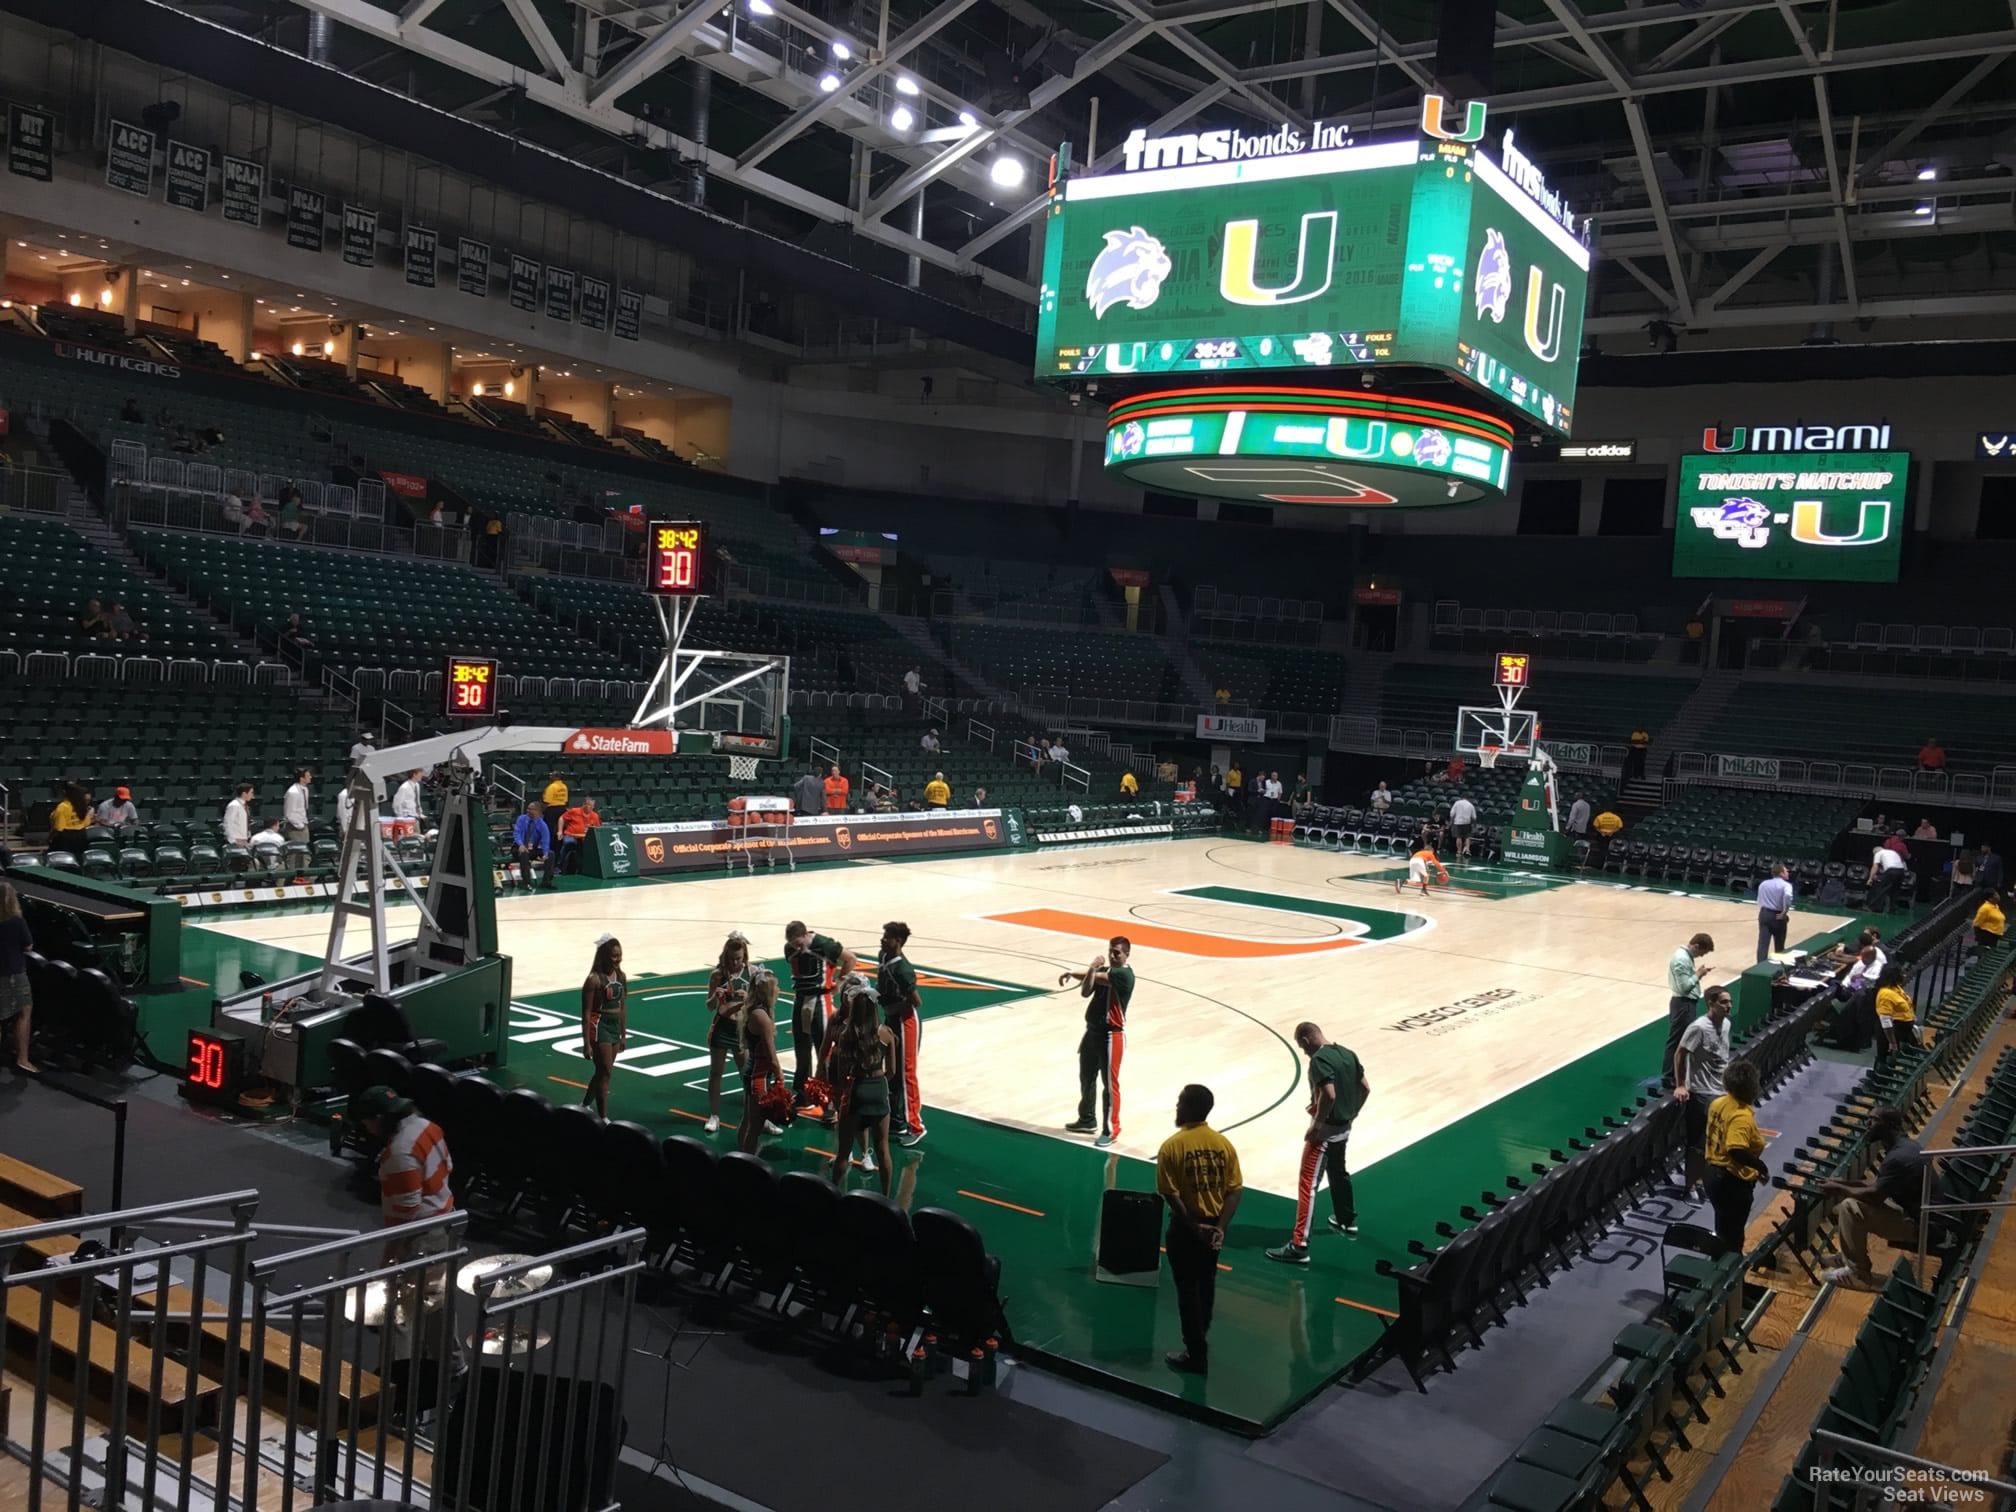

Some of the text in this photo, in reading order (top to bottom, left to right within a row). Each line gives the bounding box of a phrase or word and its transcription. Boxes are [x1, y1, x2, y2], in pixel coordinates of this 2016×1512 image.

[20, 113, 45, 137] NIT
[1422, 94, 1487, 142] U
[117, 128, 148, 152] ACC
[1310, 121, 1353, 150] Inc.
[174, 148, 203, 171] ACC
[1438, 143, 1467, 157] MIAMI
[225, 162, 260, 187] NCAA
[293, 190, 321, 214] NCAA
[346, 211, 375, 233] NIT
[408, 231, 434, 252] NIT
[461, 242, 487, 264] NCAA
[1219, 210, 1338, 307] U
[514, 260, 538, 281] NIT
[548, 270, 572, 289] NIT
[584, 280, 606, 300] NIT
[1524, 265, 1566, 363] U
[1260, 338, 1272, 356] 0
[1349, 333, 1392, 345] 2 FOULS
[1058, 348, 1081, 358] FOULS
[1105, 342, 1173, 373] U 0
[1194, 341, 1237, 359] 38:42
[1358, 348, 1391, 359] 4 TOL
[77, 348, 181, 379] Hurricanes
[1058, 362, 1072, 370] TOL
[1326, 417, 1387, 459] U
[1703, 427, 1747, 453] U
[1587, 445, 1632, 457] adidas
[1698, 472, 1893, 491] TONIGHT'S MATCHUP
[1791, 501, 1892, 546] U
[658, 529, 698, 549] 38:42
[661, 551, 692, 585] 30
[1501, 656, 1526, 667] 38:42
[453, 665, 489, 682] 38:42
[1502, 666, 1522, 683] 30
[458, 685, 481, 706] 30
[673, 844, 698, 854] Official
[700, 842, 733, 854] Corporate
[759, 839, 766, 849] of
[1504, 851, 1550, 863] WILLIAMSON
[191, 1038, 224, 1088] 30
[1185, 1149, 1226, 1161] APEX
